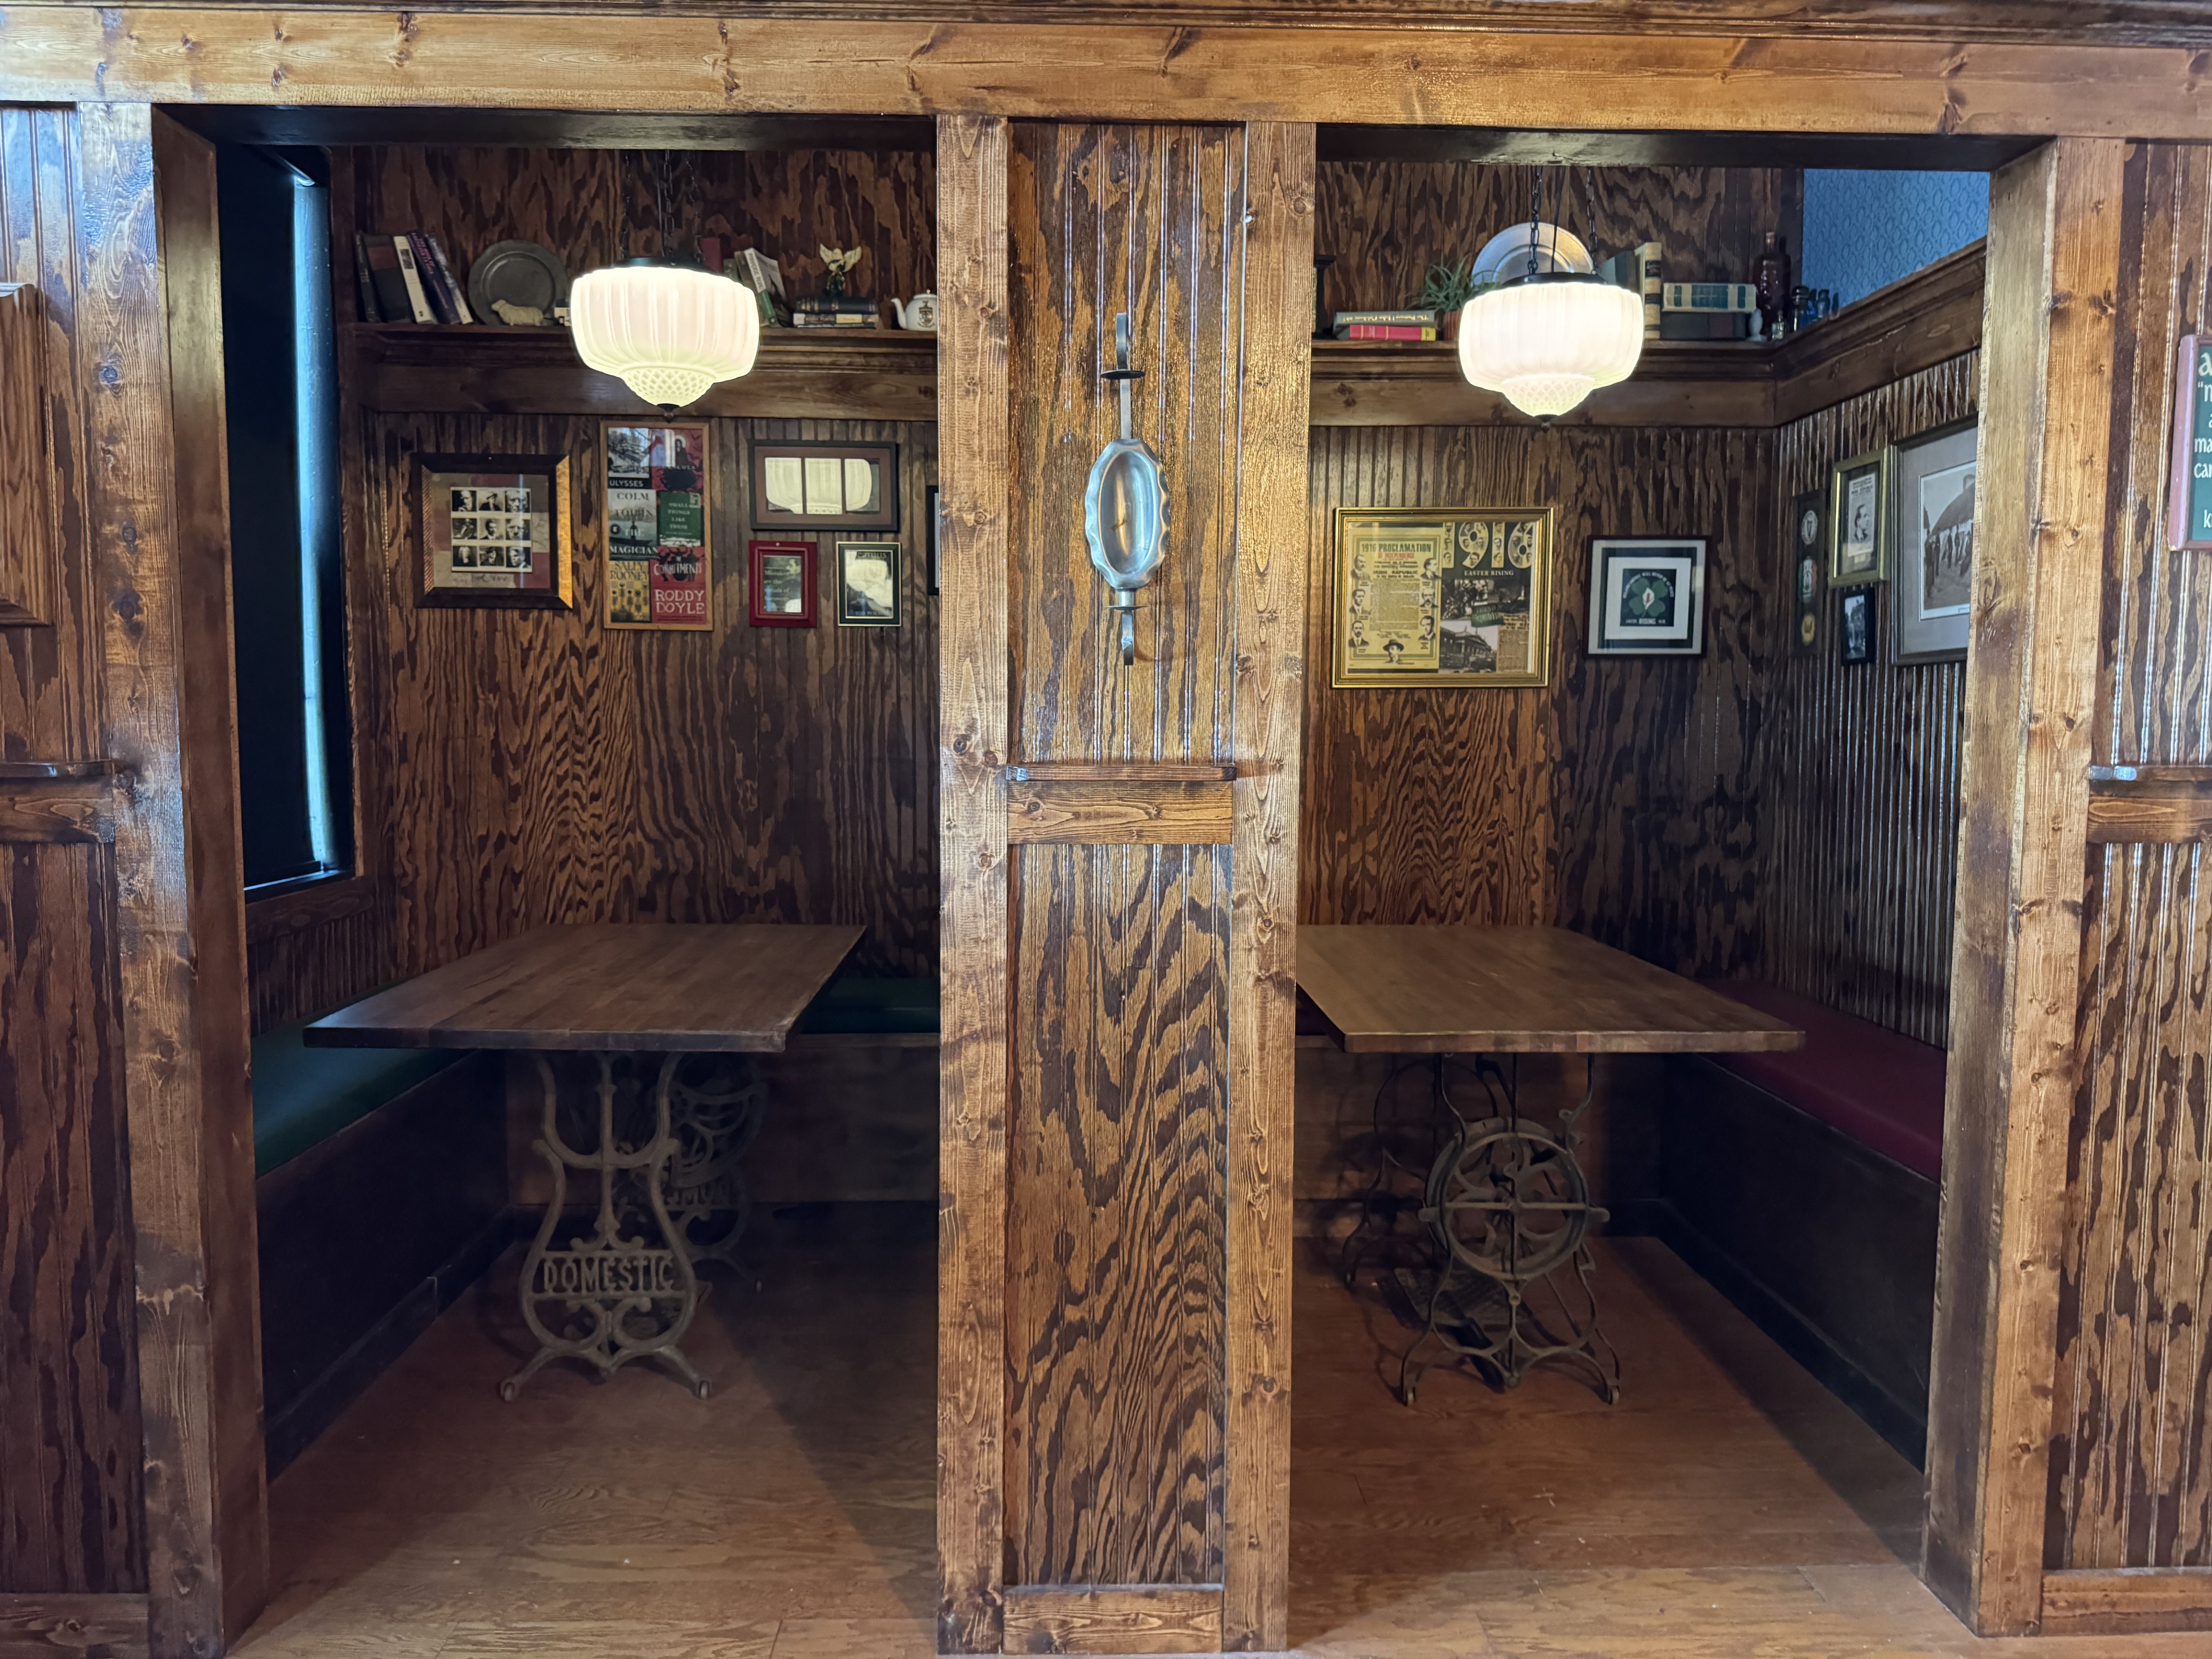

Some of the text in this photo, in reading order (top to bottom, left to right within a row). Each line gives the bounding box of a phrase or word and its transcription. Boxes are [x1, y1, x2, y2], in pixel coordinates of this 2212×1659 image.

[617, 492, 649, 501] COLM
[610, 545, 658, 554] MAGICIAN
[1362, 543, 1431, 553] 1916 PROCLAMATION
[1442, 522, 1533, 569] 1916
[615, 562, 645, 571] SALLY
[610, 570, 649, 580] ROONEY
[655, 589, 704, 601] RODDY
[656, 602, 705, 614] DOYLE
[544, 1258, 674, 1294] DOMESTIC
